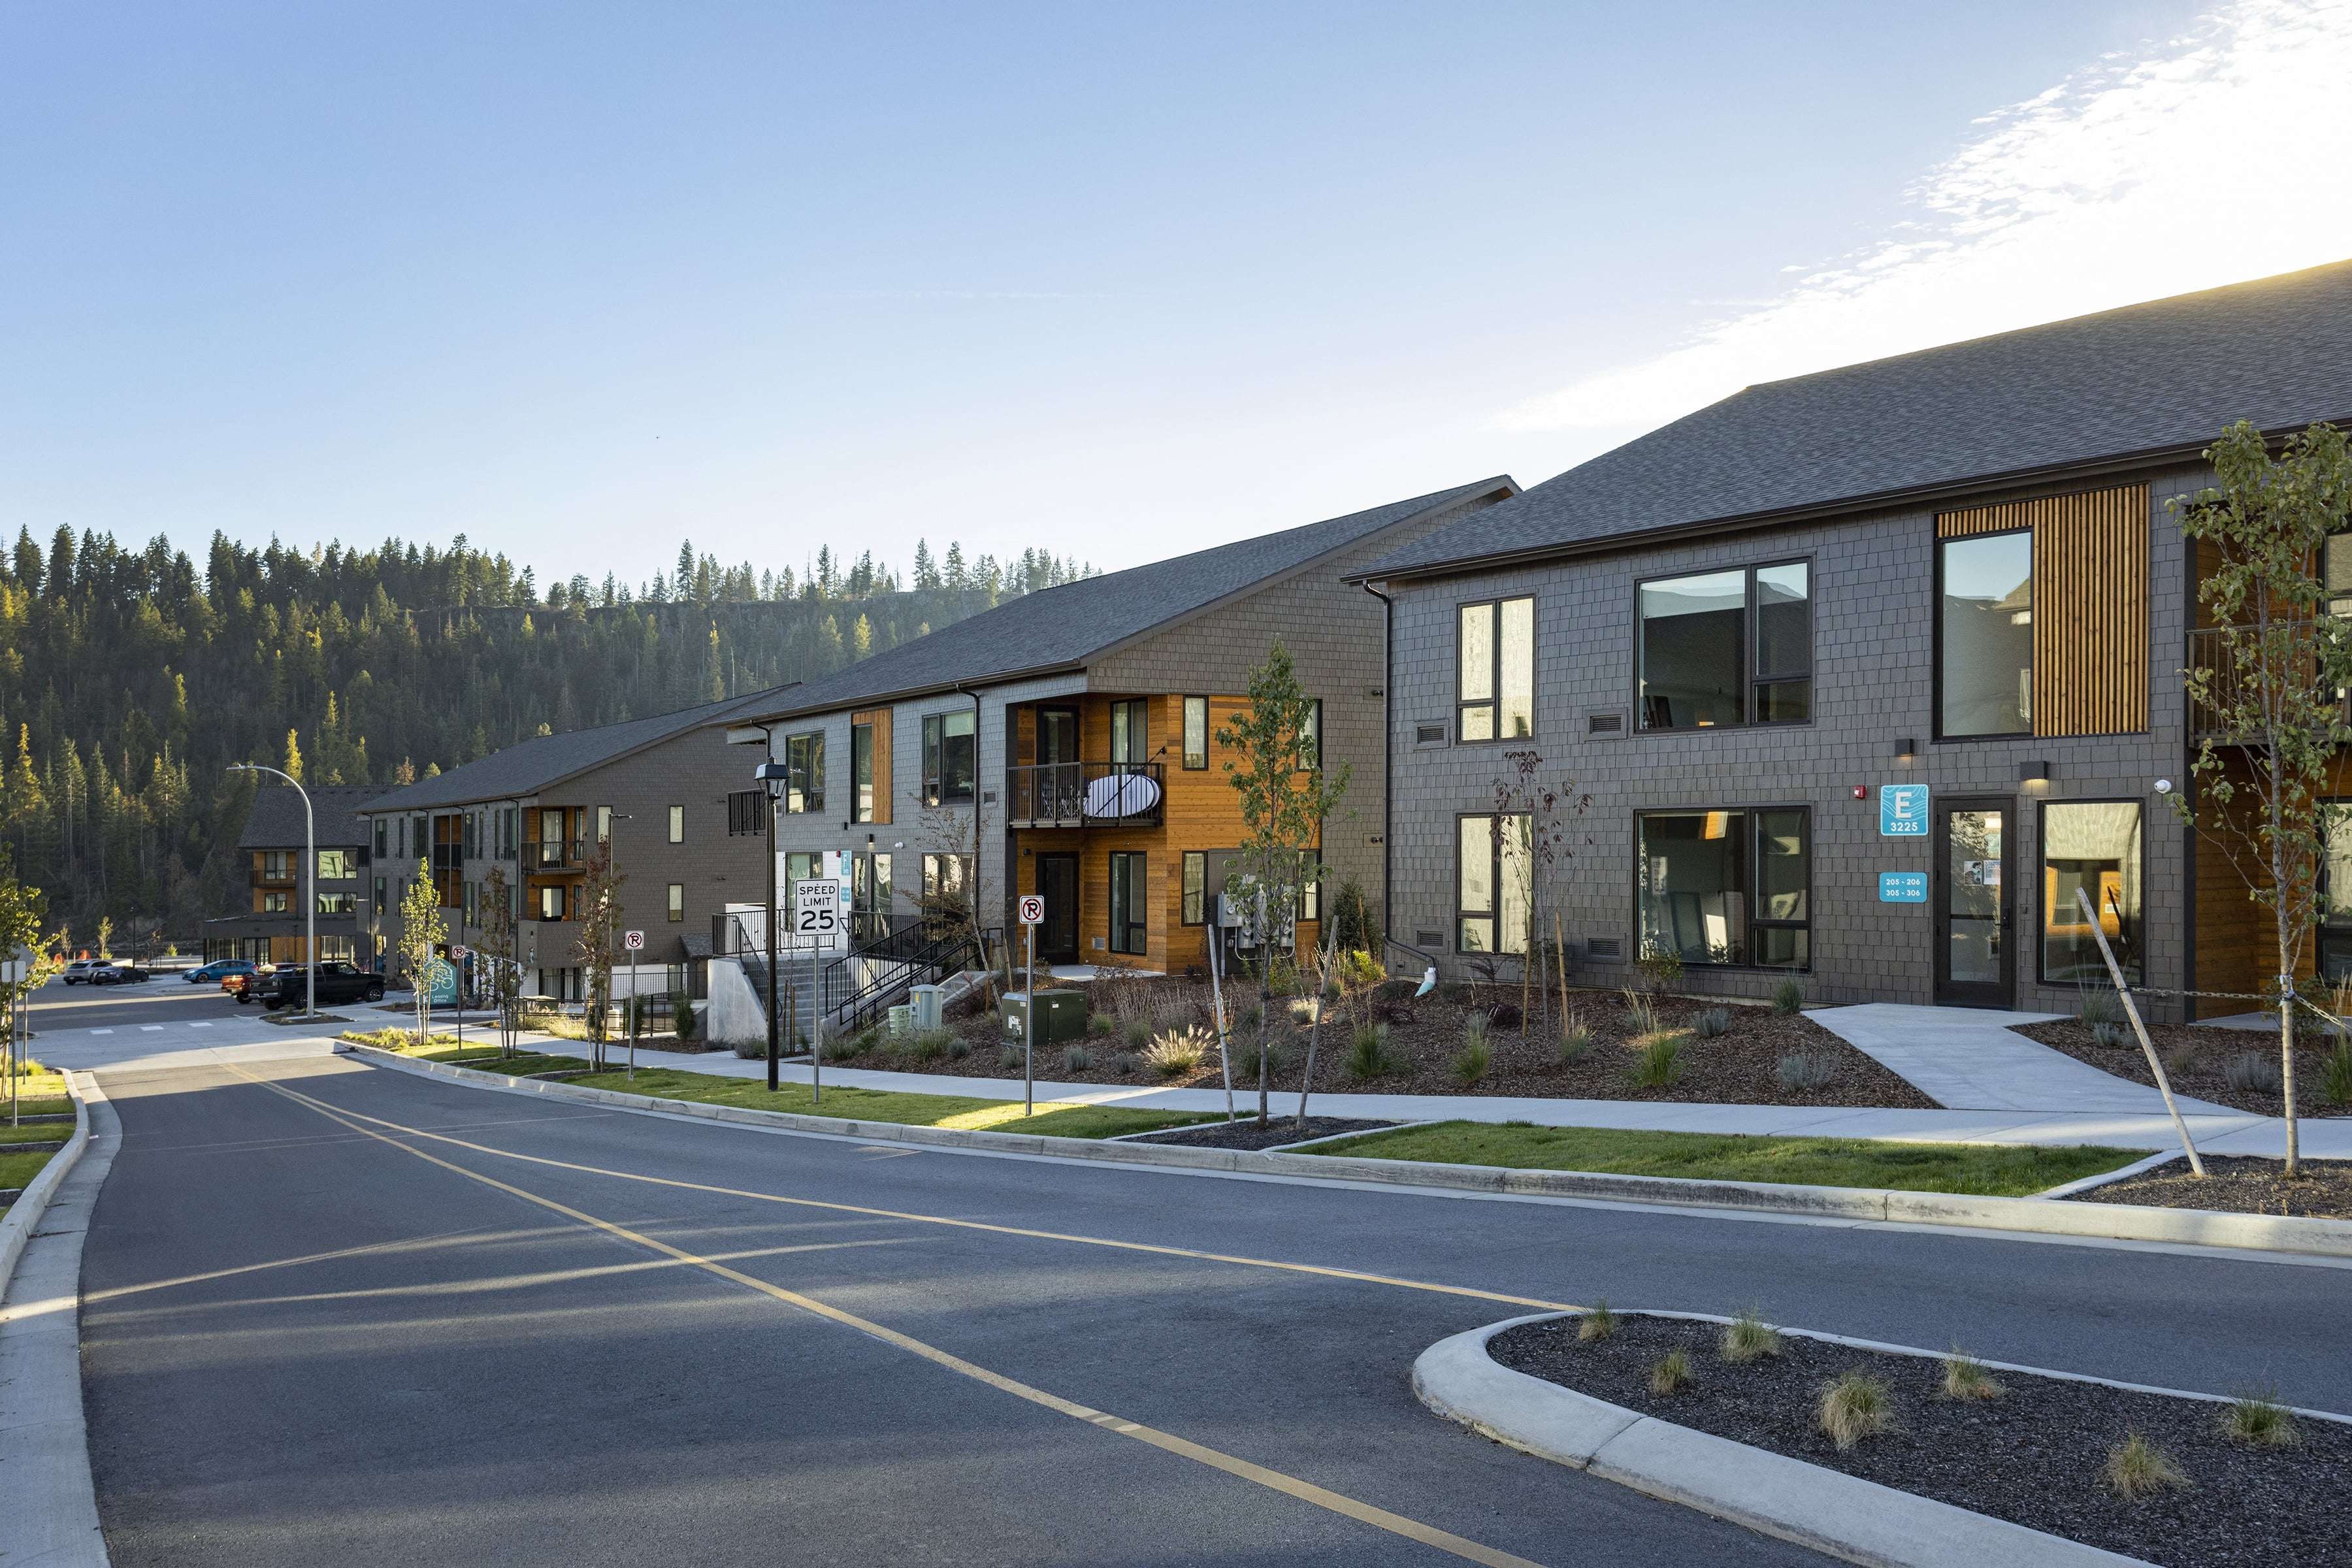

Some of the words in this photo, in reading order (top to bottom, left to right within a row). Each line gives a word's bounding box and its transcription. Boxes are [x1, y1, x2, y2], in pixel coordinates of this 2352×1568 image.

[1896, 791, 1912, 818] E
[1890, 822, 1918, 832] 3225
[799, 886, 836, 895] SPEED
[804, 897, 832, 907] LIMIT
[800, 909, 834, 930] 25
